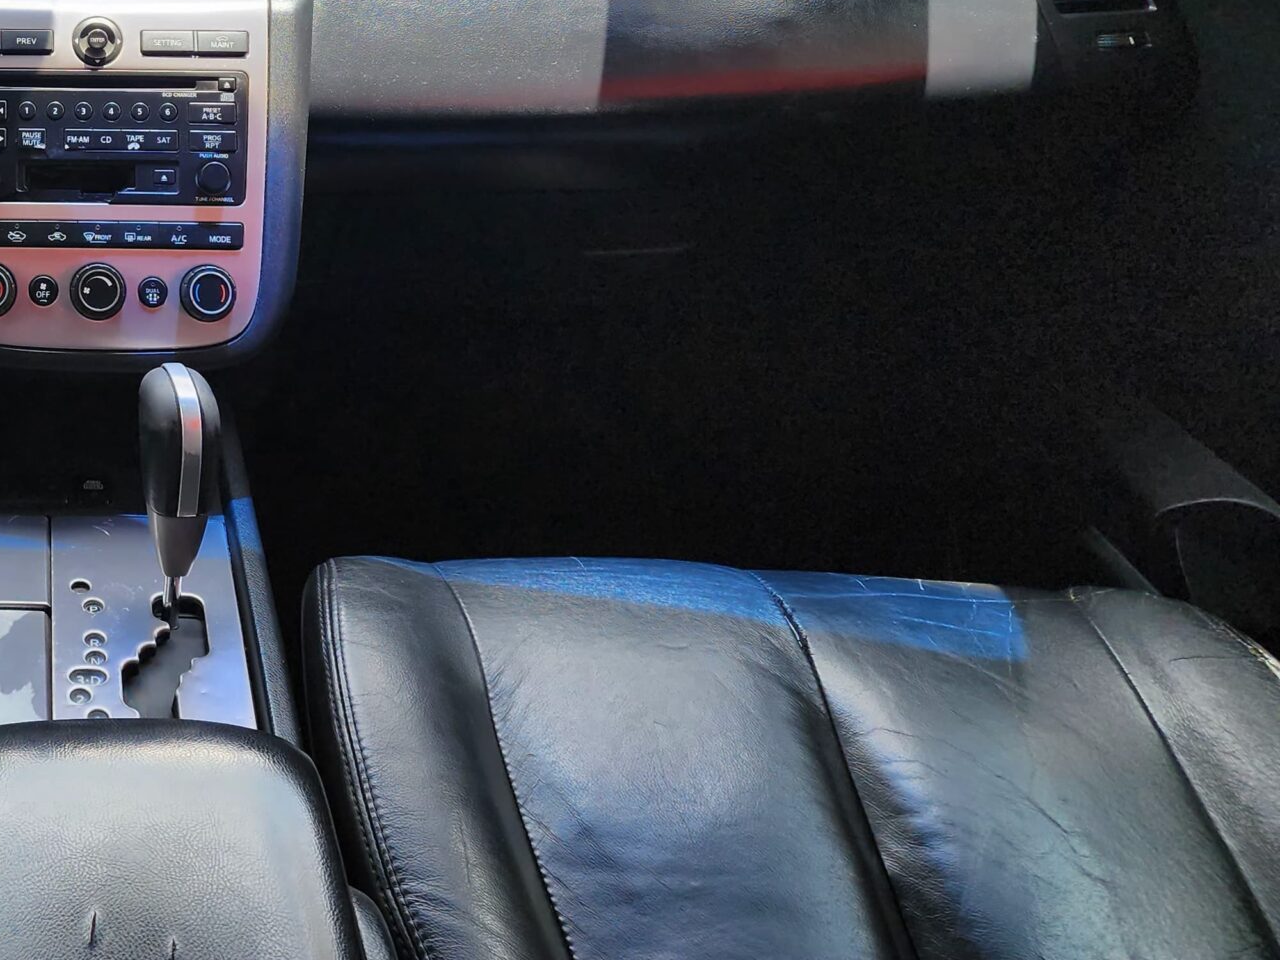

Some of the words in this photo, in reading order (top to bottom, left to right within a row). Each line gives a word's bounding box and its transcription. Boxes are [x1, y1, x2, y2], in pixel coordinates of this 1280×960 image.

[16, 36, 38, 46] PREV
[153, 39, 183, 47] SETTING
[210, 41, 236, 49] MAINT
[24, 106, 30, 115] 1
[52, 107, 58, 115] 2
[81, 107, 87, 115] 3
[108, 107, 115, 115] 4
[137, 108, 143, 116] 5
[164, 108, 171, 116] 6
[100, 136, 112, 144] CD
[126, 134, 145, 142] TAPE
[156, 136, 171, 144] SAT
[171, 234, 187, 242] A/C
[209, 235, 232, 244] MODE
[35, 290, 51, 299] OFF
[89, 638, 100, 648] R
[90, 657, 100, 666] N
